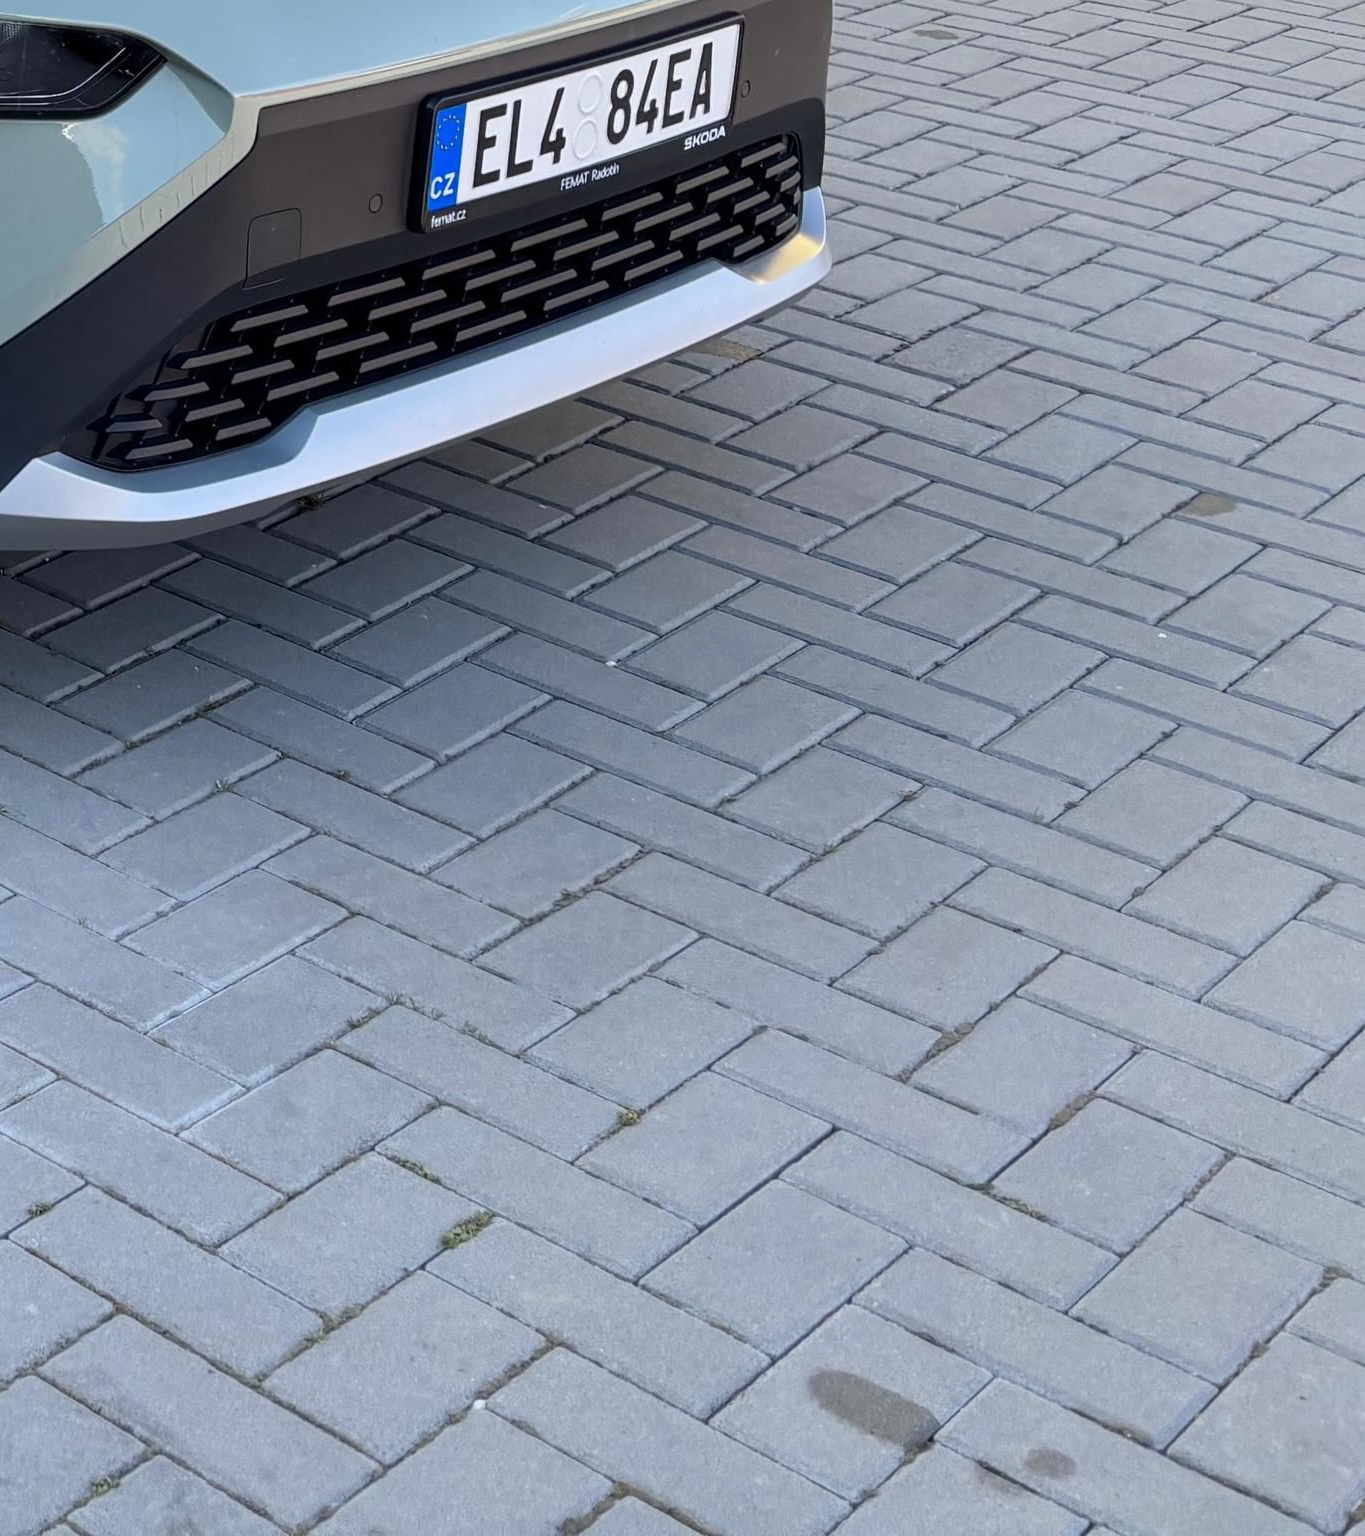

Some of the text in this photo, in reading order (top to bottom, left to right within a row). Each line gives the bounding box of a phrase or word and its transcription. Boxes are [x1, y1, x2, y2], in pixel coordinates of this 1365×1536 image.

[472, 42, 713, 188] EL4 84EA
[430, 171, 456, 200] CZ
[560, 171, 590, 191] FEMAT
[431, 209, 467, 228] femat.cz
